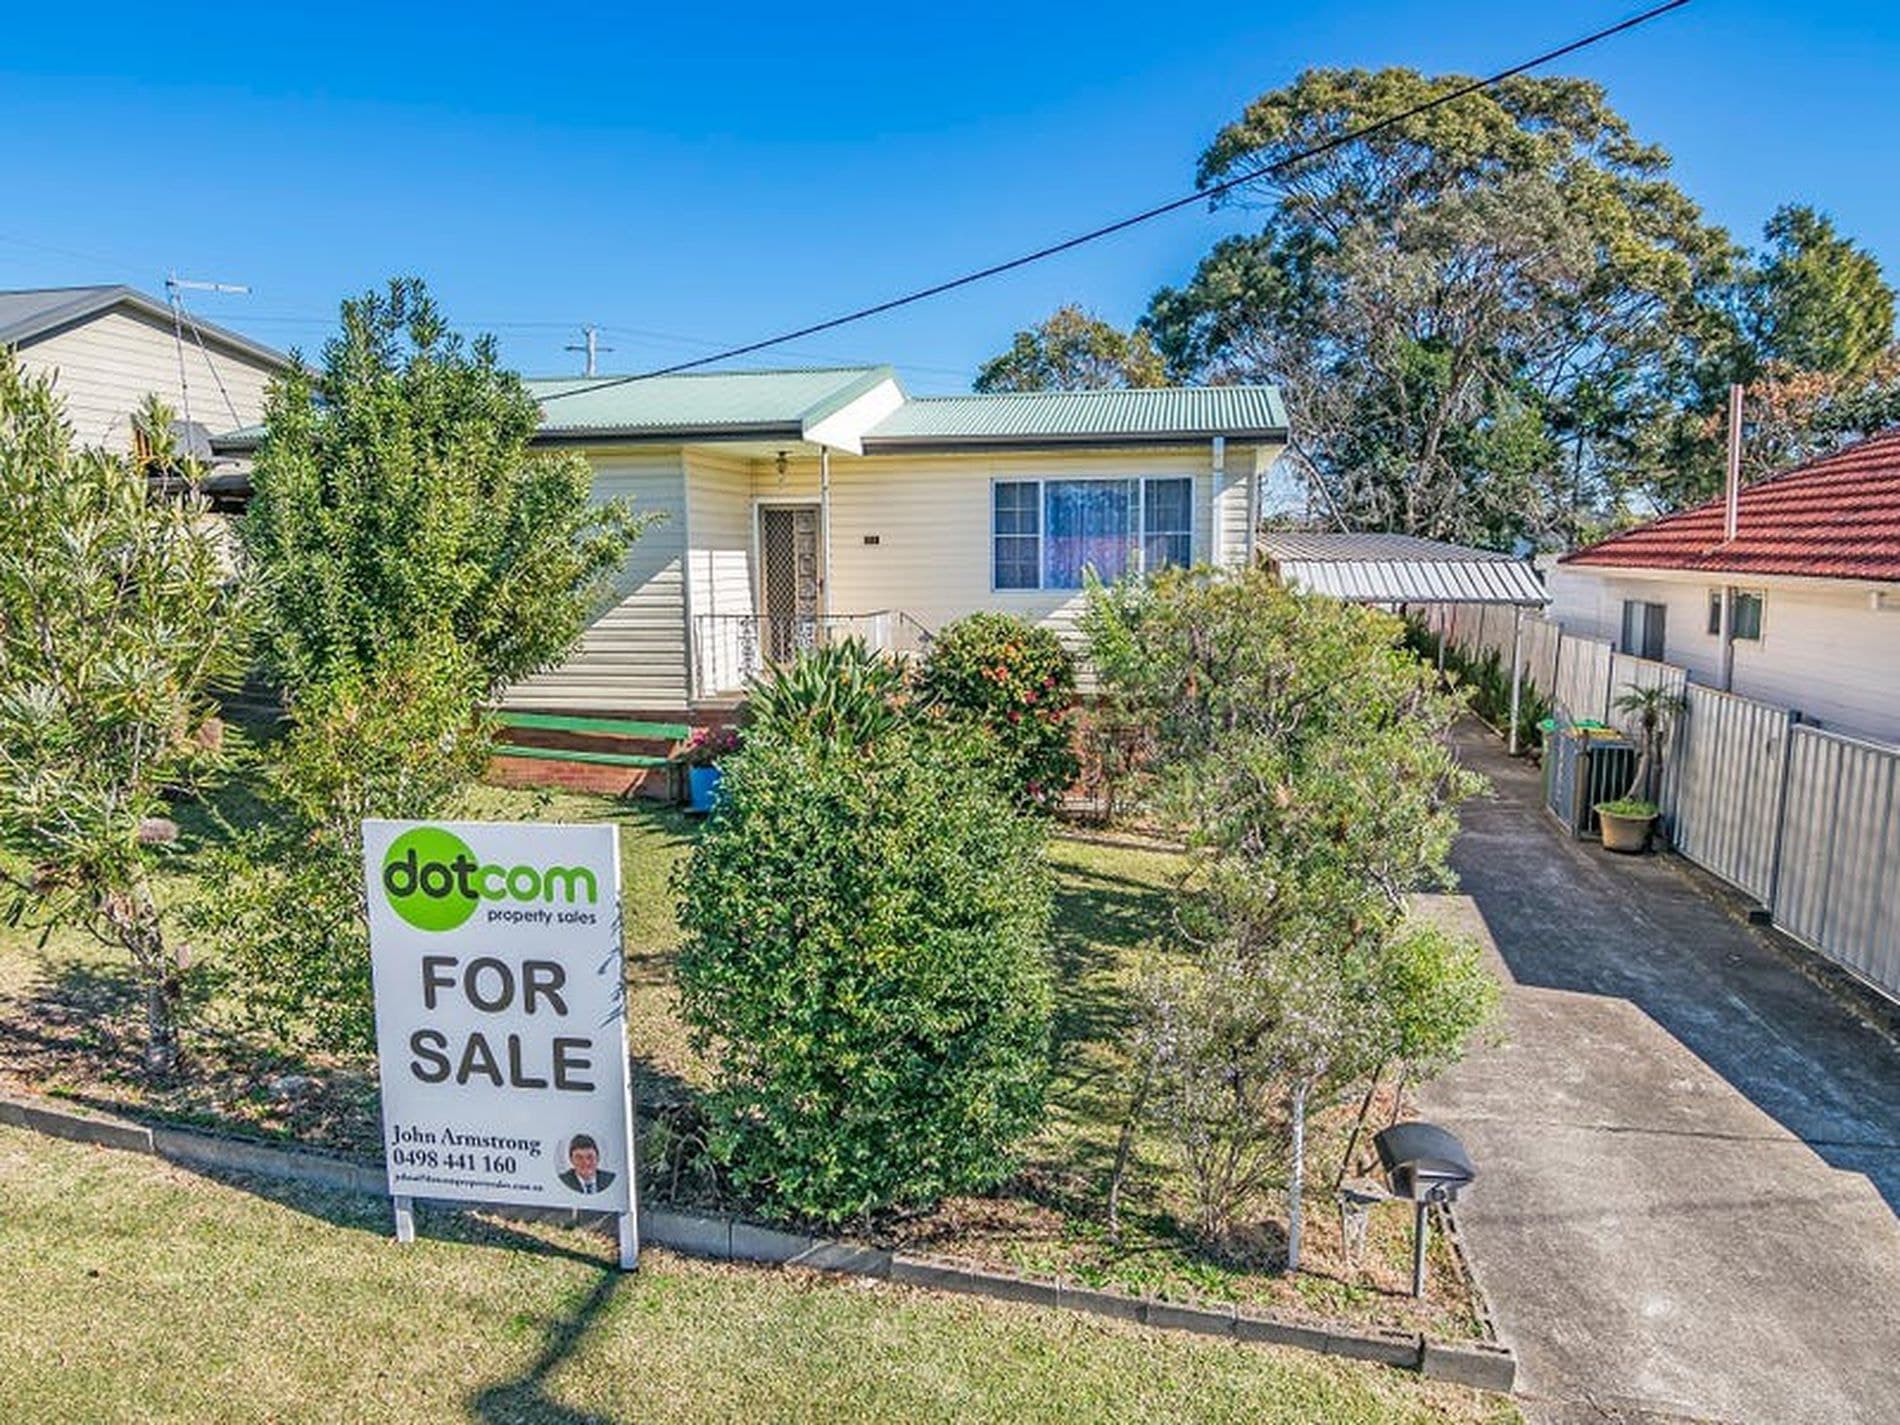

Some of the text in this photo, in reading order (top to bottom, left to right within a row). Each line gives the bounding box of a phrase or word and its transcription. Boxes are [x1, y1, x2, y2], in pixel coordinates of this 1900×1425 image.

[383, 848, 598, 904] dotcom
[487, 908, 597, 925] property sales
[422, 955, 569, 1017] FOR
[409, 1028, 596, 1093] SALE
[391, 1124, 542, 1157] John Armstrong
[393, 1149, 517, 1174] 0498 441 160
